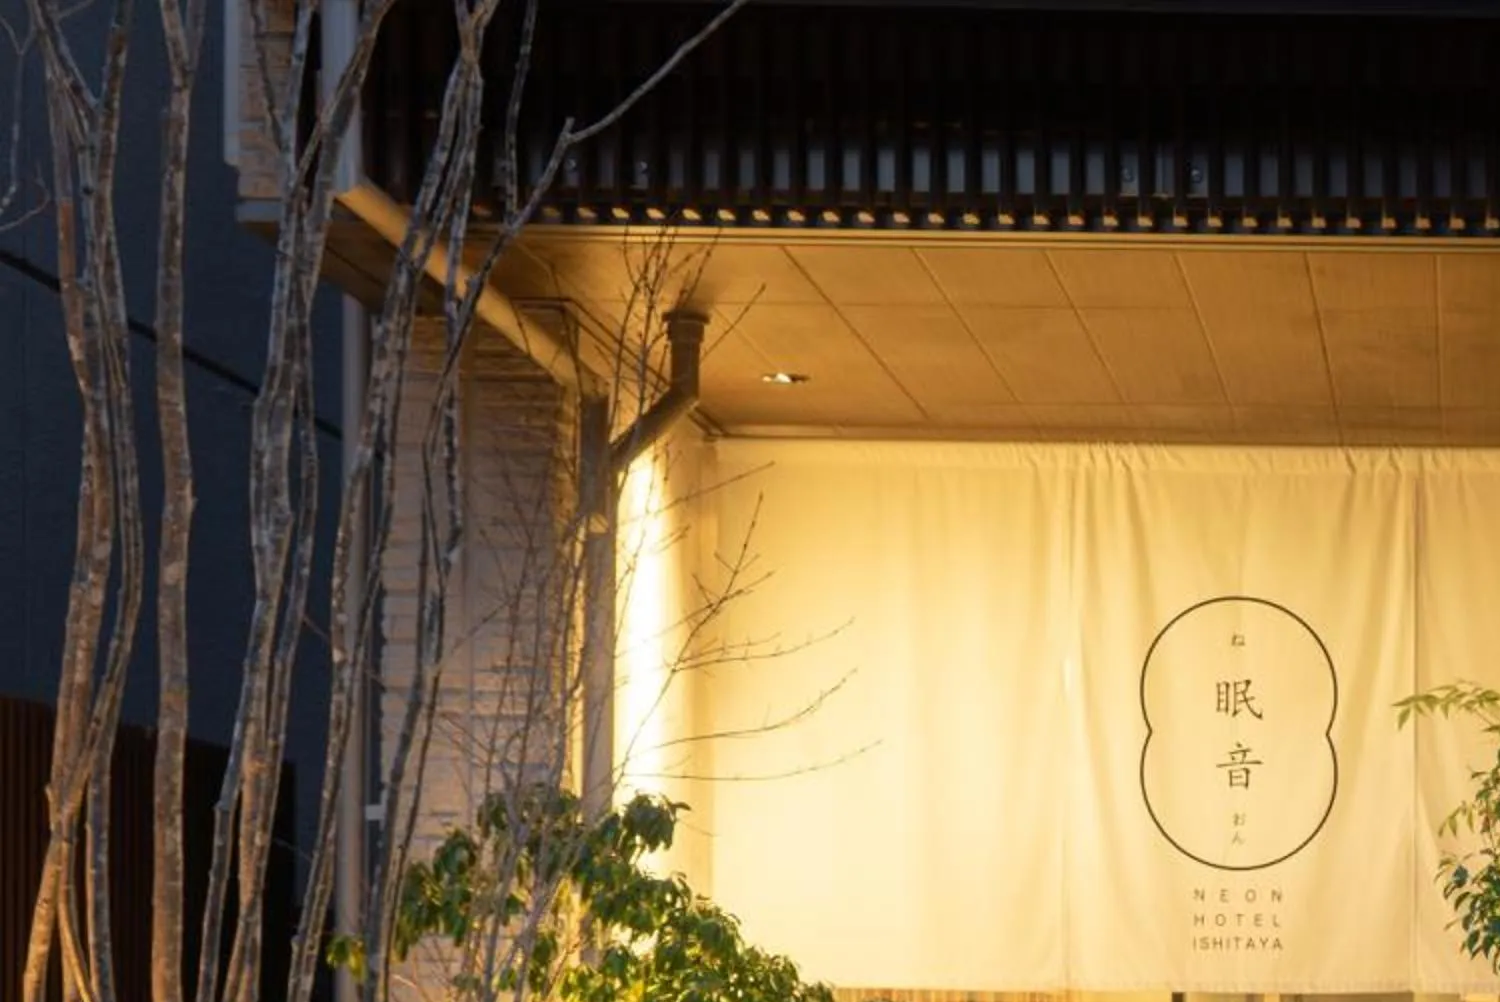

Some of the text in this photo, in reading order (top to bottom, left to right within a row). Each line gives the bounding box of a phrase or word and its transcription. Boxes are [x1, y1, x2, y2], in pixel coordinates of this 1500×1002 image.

[1215, 678, 1264, 790] 眠音
[1193, 888, 1283, 902] NEON
[1193, 912, 1281, 927] HOTEL
[1192, 936, 1284, 950] ISHITAYA
